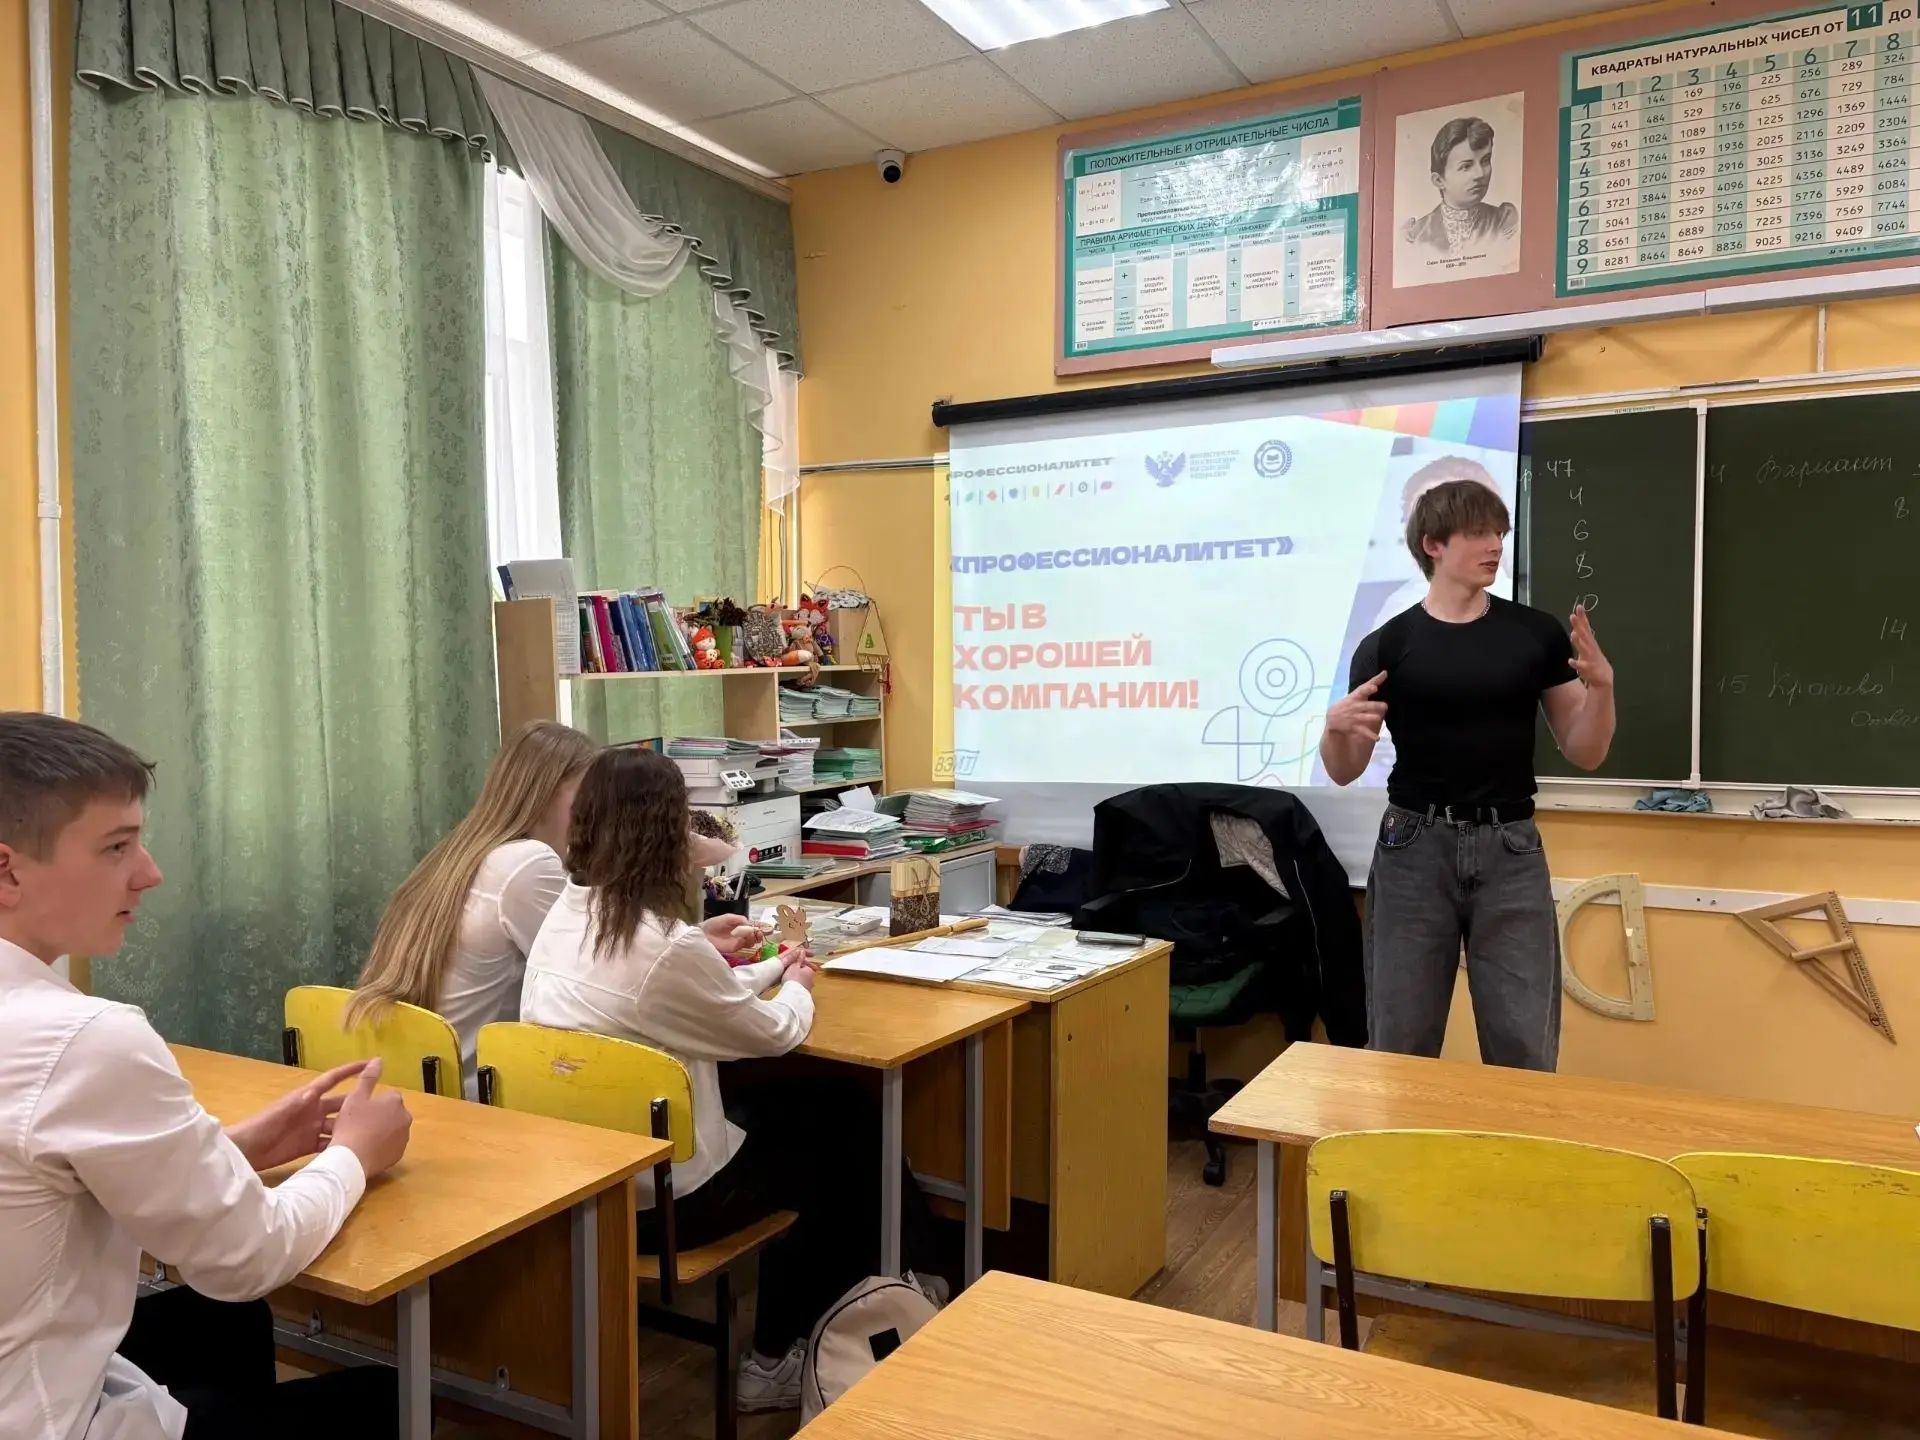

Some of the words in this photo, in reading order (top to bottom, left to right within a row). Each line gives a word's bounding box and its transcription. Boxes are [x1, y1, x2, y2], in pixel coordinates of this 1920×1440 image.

[1591, 53, 1662, 76] КВАДРАТЫ
[1666, 36, 1767, 63] НАТУРАЛЬНЫХ
[1771, 25, 1820, 43] ЧИСЕЛ
[1824, 21, 1844, 33] ОТ
[1851, 6, 1878, 26] 11
[1889, 9, 1911, 23] ДО
[1617, 82, 1624, 97] 1
[1651, 76, 1661, 91] 2
[1688, 69, 1699, 85] 3
[1726, 62, 1737, 78] 4
[1765, 55, 1775, 71] 5
[1804, 48, 1816, 64] 6
[1846, 41, 1857, 58] 7
[1887, 33, 1900, 49] 8
[1581, 123, 1590, 139] 2
[1611, 120, 1628, 130] 441
[1647, 114, 1664, 124] 484
[1684, 108, 1702, 118] 529
[1722, 101, 1741, 112] 576
[1761, 94, 1780, 105] 625
[1801, 88, 1820, 98] 676
[1842, 81, 1862, 92] 729
[1884, 74, 1904, 85] 784
[1583, 104, 1590, 119] 1
[1611, 100, 1629, 111] 121
[1647, 94, 1665, 104] 144
[1684, 88, 1703, 98] 169
[1723, 81, 1741, 92] 196
[1761, 74, 1780, 85] 225
[1801, 67, 1821, 79] 256
[1842, 60, 1862, 72] 289
[1884, 53, 1904, 64] 324
[1090, 144, 1182, 169] ПОЛОЖИТЕЛЬНЫЕ
[1184, 142, 1192, 152] И
[1195, 125, 1289, 150] ОТРИЦАТЕЛЬНЫЕ
[1291, 117, 1330, 133] ЧИСЛА
[1580, 162, 1590, 178] 4
[1607, 159, 1632, 169] 1681
[1642, 153, 1667, 163] 1764
[1680, 147, 1705, 158] 1849
[1719, 141, 1744, 152] 1936
[1757, 134, 1783, 146] 2025
[1797, 128, 1824, 140] 2116
[1837, 122, 1865, 134] 2209
[1879, 116, 1907, 128] 2304
[1581, 142, 1590, 158] 3
[1610, 139, 1628, 150] 961
[1643, 134, 1668, 144] 1024
[1681, 127, 1706, 138] 1089
[1719, 121, 1744, 132] 1156
[1758, 114, 1783, 126] 1225
[1797, 108, 1824, 119] 1296
[1838, 102, 1865, 113] 1369
[1880, 95, 1907, 106] 1444
[1579, 201, 1589, 216] 6
[1606, 197, 1630, 208] 3721
[1642, 192, 1666, 203] 3844
[1680, 186, 1705, 198] 3969
[1717, 181, 1743, 191] 4096
[1757, 175, 1782, 186] 4225
[1796, 169, 1823, 180] 4356
[1837, 164, 1864, 175] 4489
[1878, 158, 1906, 169] 4624
[1580, 181, 1589, 196] 5
[1606, 178, 1631, 189] 2601
[1641, 172, 1667, 184] 2704
[1680, 166, 1705, 178] 2809
[1718, 161, 1744, 172] 2916
[1757, 155, 1783, 166] 3025
[1796, 149, 1823, 160] 3136
[1837, 143, 1864, 155] 3249
[1878, 137, 1906, 149] 3364
[1578, 220, 1589, 235] 7
[1605, 217, 1630, 228] 5041
[1641, 212, 1666, 223] 5184
[1679, 205, 1704, 217] 5329
[1717, 201, 1743, 212] 5476
[1756, 196, 1782, 207] 5625
[1795, 190, 1823, 201] 5776
[1836, 185, 1864, 196] 5929
[1878, 178, 1905, 190] 6084
[1578, 240, 1588, 255] 8
[1605, 237, 1629, 247] 6561
[1641, 232, 1666, 242] 6724
[1678, 226, 1704, 237] 6889
[1717, 221, 1744, 232] 7056
[1755, 216, 1782, 227] 7225
[1796, 211, 1823, 222] 7396
[1836, 205, 1863, 216] 7569
[1878, 200, 1905, 211] 7744
[1080, 234, 1115, 246] ПРАВИЛА
[1118, 224, 1195, 241] АРИФМЕТИЧЕСКИХ
[1577, 258, 1588, 274] 9
[1604, 256, 1629, 266] 8281
[1640, 251, 1665, 261] 8464
[1678, 246, 1703, 257] 8649
[1716, 241, 1742, 252] 8836
[1756, 236, 1782, 247] 9025
[1795, 231, 1822, 242] 9216
[1836, 226, 1863, 238] 9409
[1877, 221, 1904, 232] 9604
[950, 536, 1294, 574] «ПРОФЕССИОНАЛИТЕТ»
[1573, 519, 1589, 541] 6
[1575, 550, 1594, 579] 8
[954, 604, 1015, 632] ТЫ
[1021, 604, 1046, 629] В
[953, 633, 1152, 671] ХОРОШЕЙ
[953, 679, 1199, 711] КОМПАНИИ!
